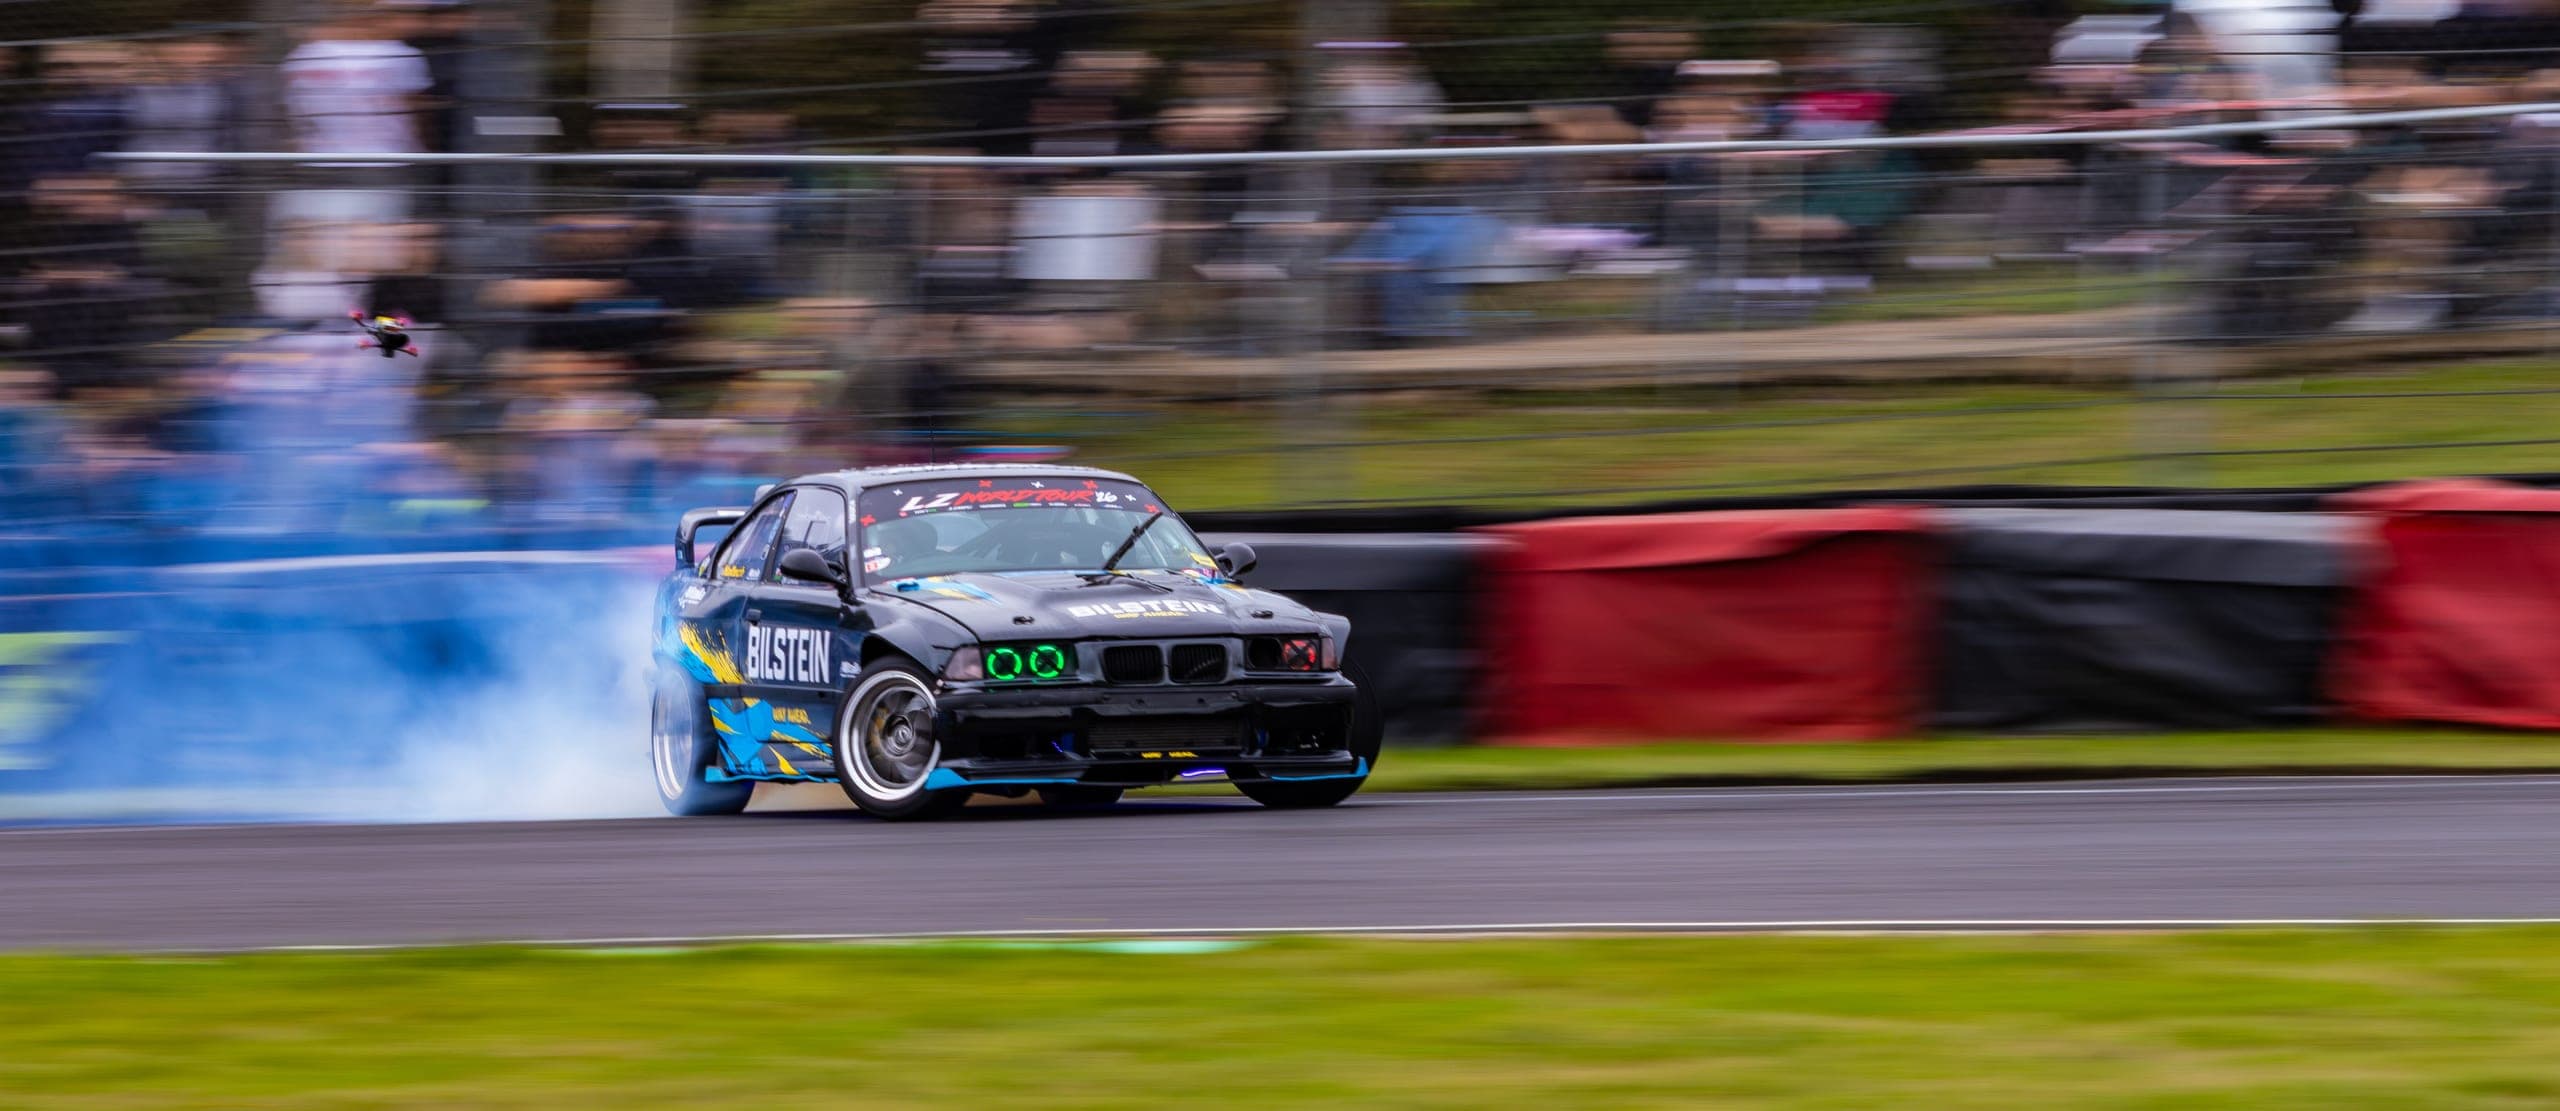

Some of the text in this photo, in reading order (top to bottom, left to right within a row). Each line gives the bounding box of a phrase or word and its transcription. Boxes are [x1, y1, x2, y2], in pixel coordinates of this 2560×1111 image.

[900, 492, 960, 512] LZ
[953, 491, 1032, 506] WORLD
[1034, 489, 1093, 503] TOUR
[1067, 600, 1224, 618] BILSTEIN
[748, 626, 830, 684] BILSTEIN
